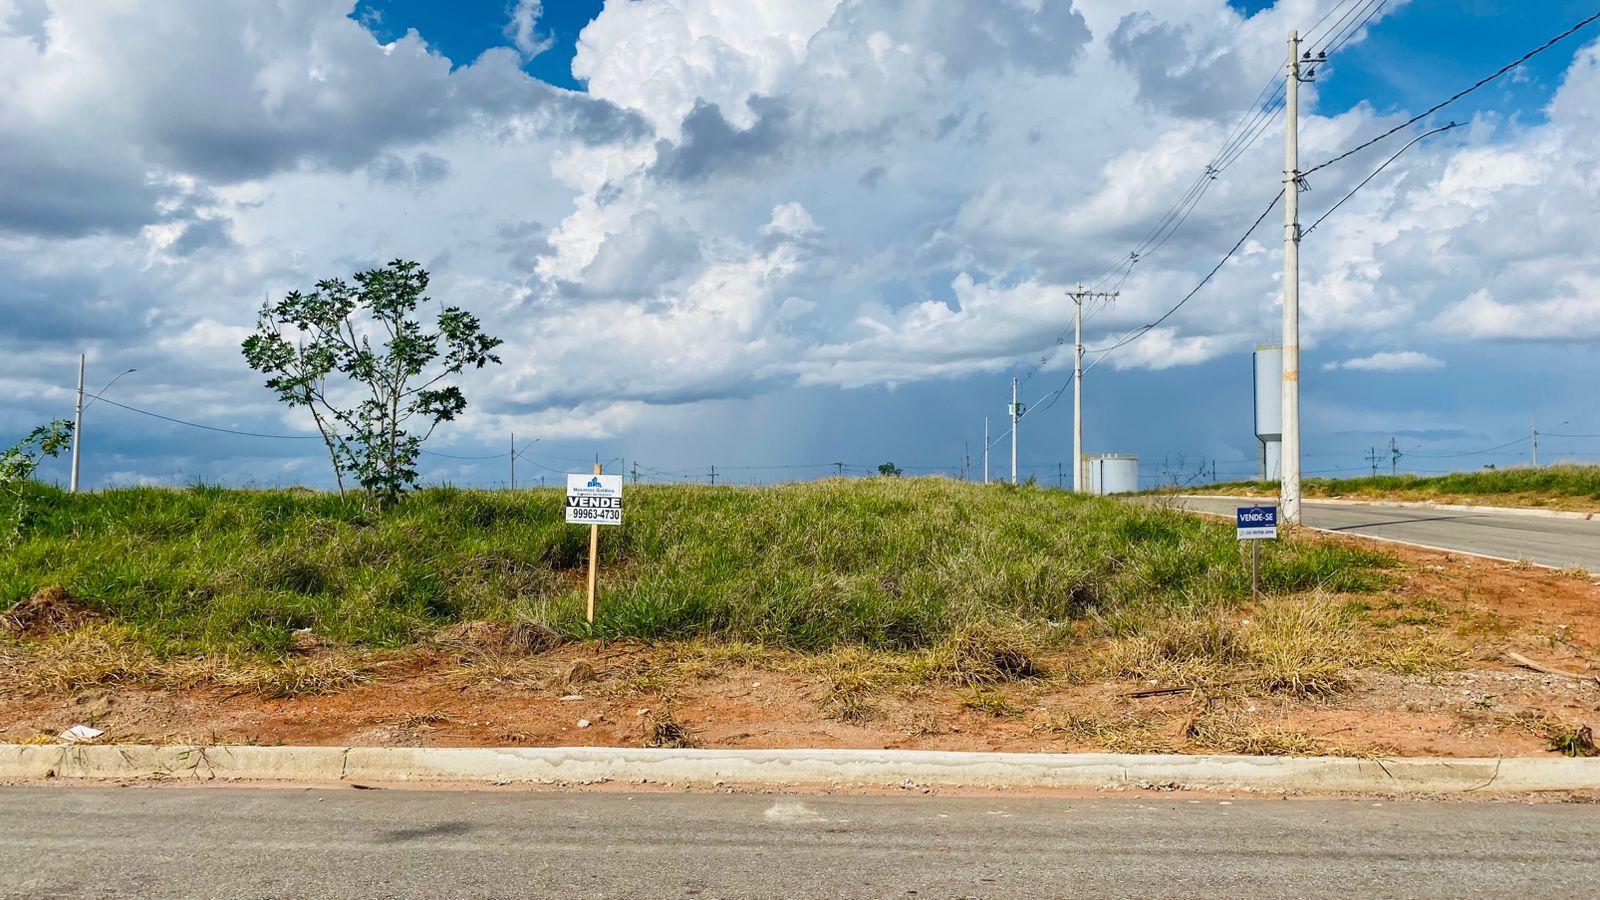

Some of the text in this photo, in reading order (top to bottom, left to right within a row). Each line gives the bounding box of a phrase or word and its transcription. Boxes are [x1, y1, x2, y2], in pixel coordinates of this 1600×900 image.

[568, 496, 621, 508] VENDE
[573, 508, 620, 520] 99963-4730
[1239, 513, 1273, 522] VENDE-SE
